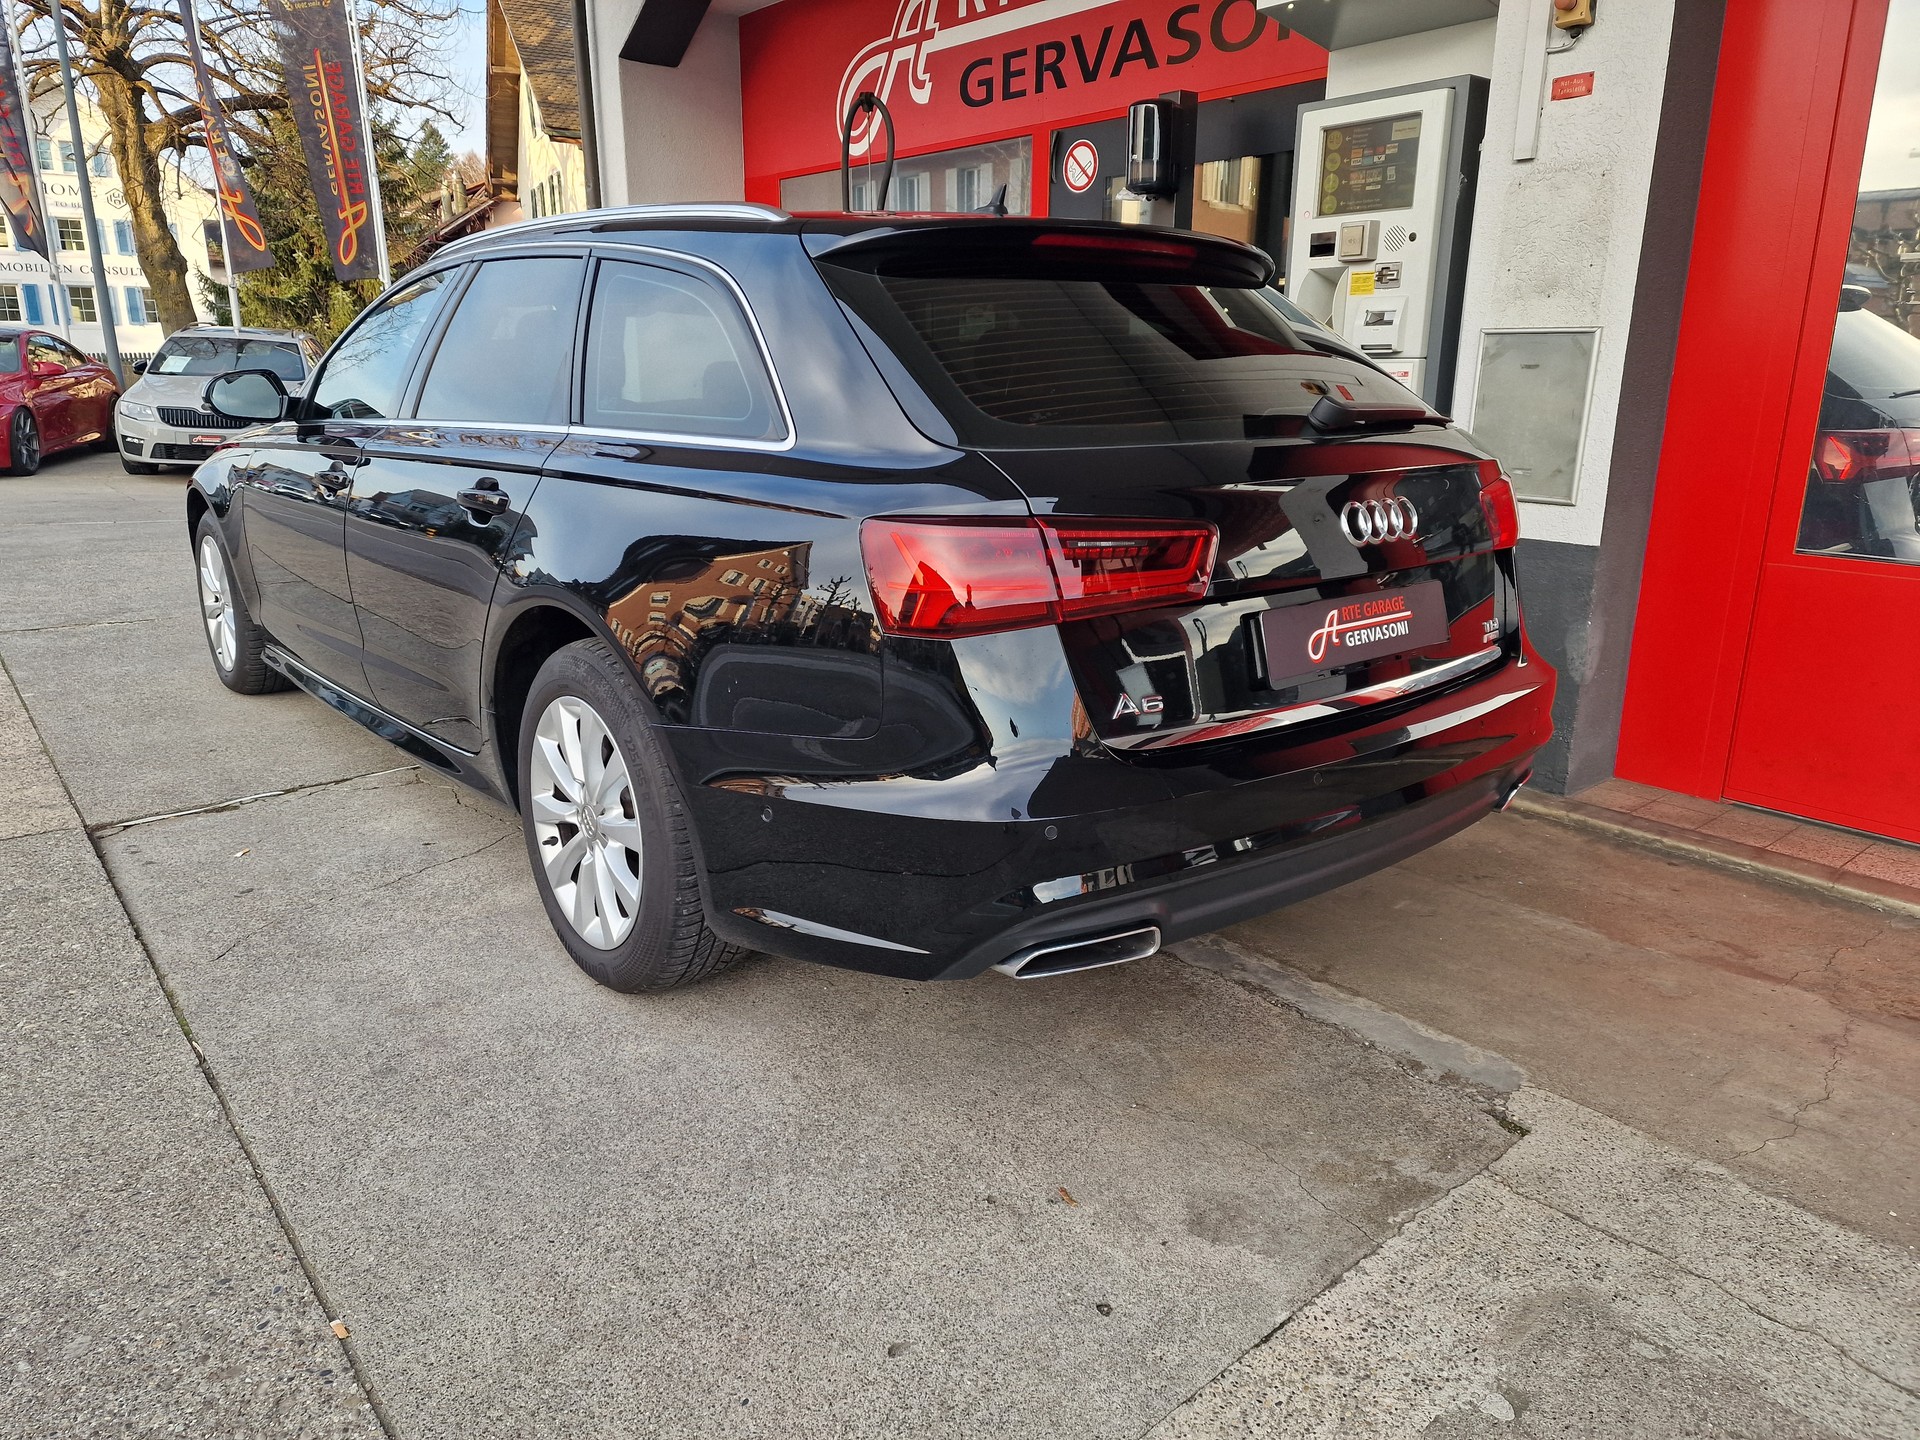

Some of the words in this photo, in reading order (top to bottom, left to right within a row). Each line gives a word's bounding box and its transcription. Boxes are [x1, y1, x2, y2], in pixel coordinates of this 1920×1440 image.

[959, 0, 1291, 107] GERVASO
[186, 40, 237, 178] GERVAS
[0, 262, 73, 274] MOBILN
[1363, 596, 1405, 617] GARAGE
[1345, 620, 1409, 647] GERVASONI
[1112, 692, 1164, 720] A6
